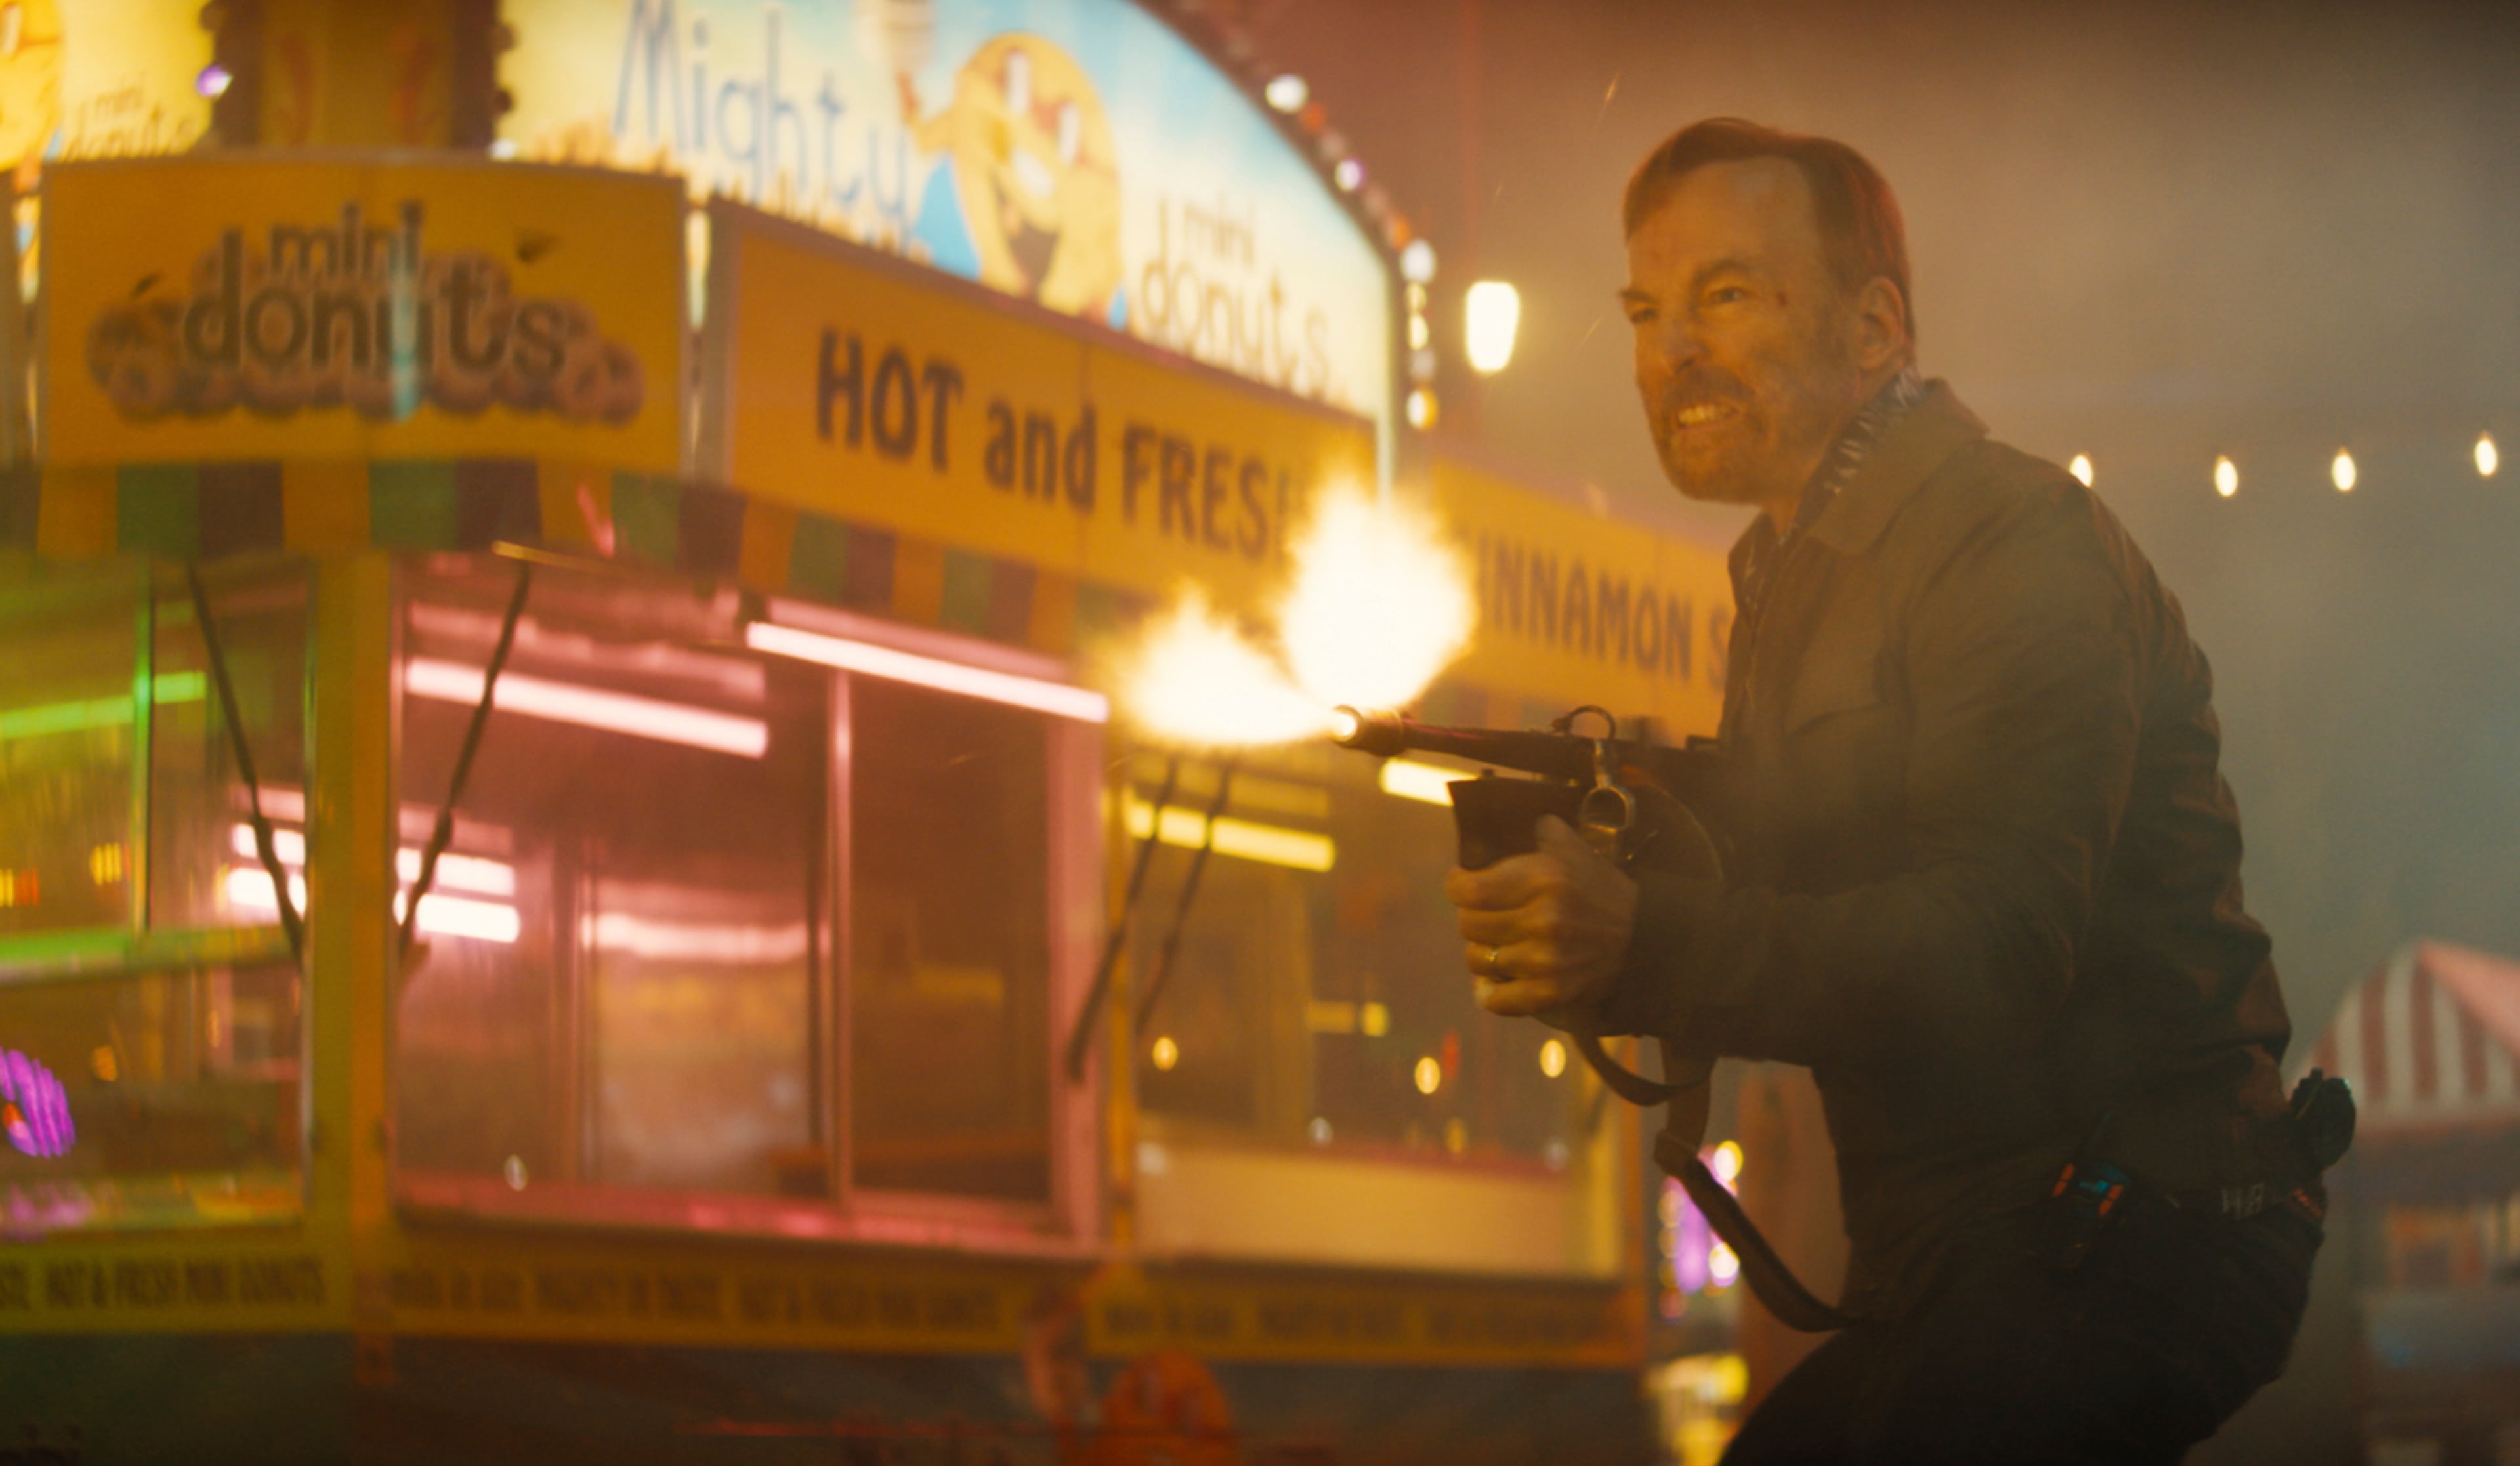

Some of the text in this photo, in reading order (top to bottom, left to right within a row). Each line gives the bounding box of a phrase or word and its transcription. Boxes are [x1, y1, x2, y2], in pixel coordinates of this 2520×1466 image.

[182, 226, 566, 374] donuts
[268, 200, 423, 270] mini
[816, 325, 964, 474] HOT
[983, 398, 1097, 517] and
[1452, 517, 1693, 685] INNAMON
